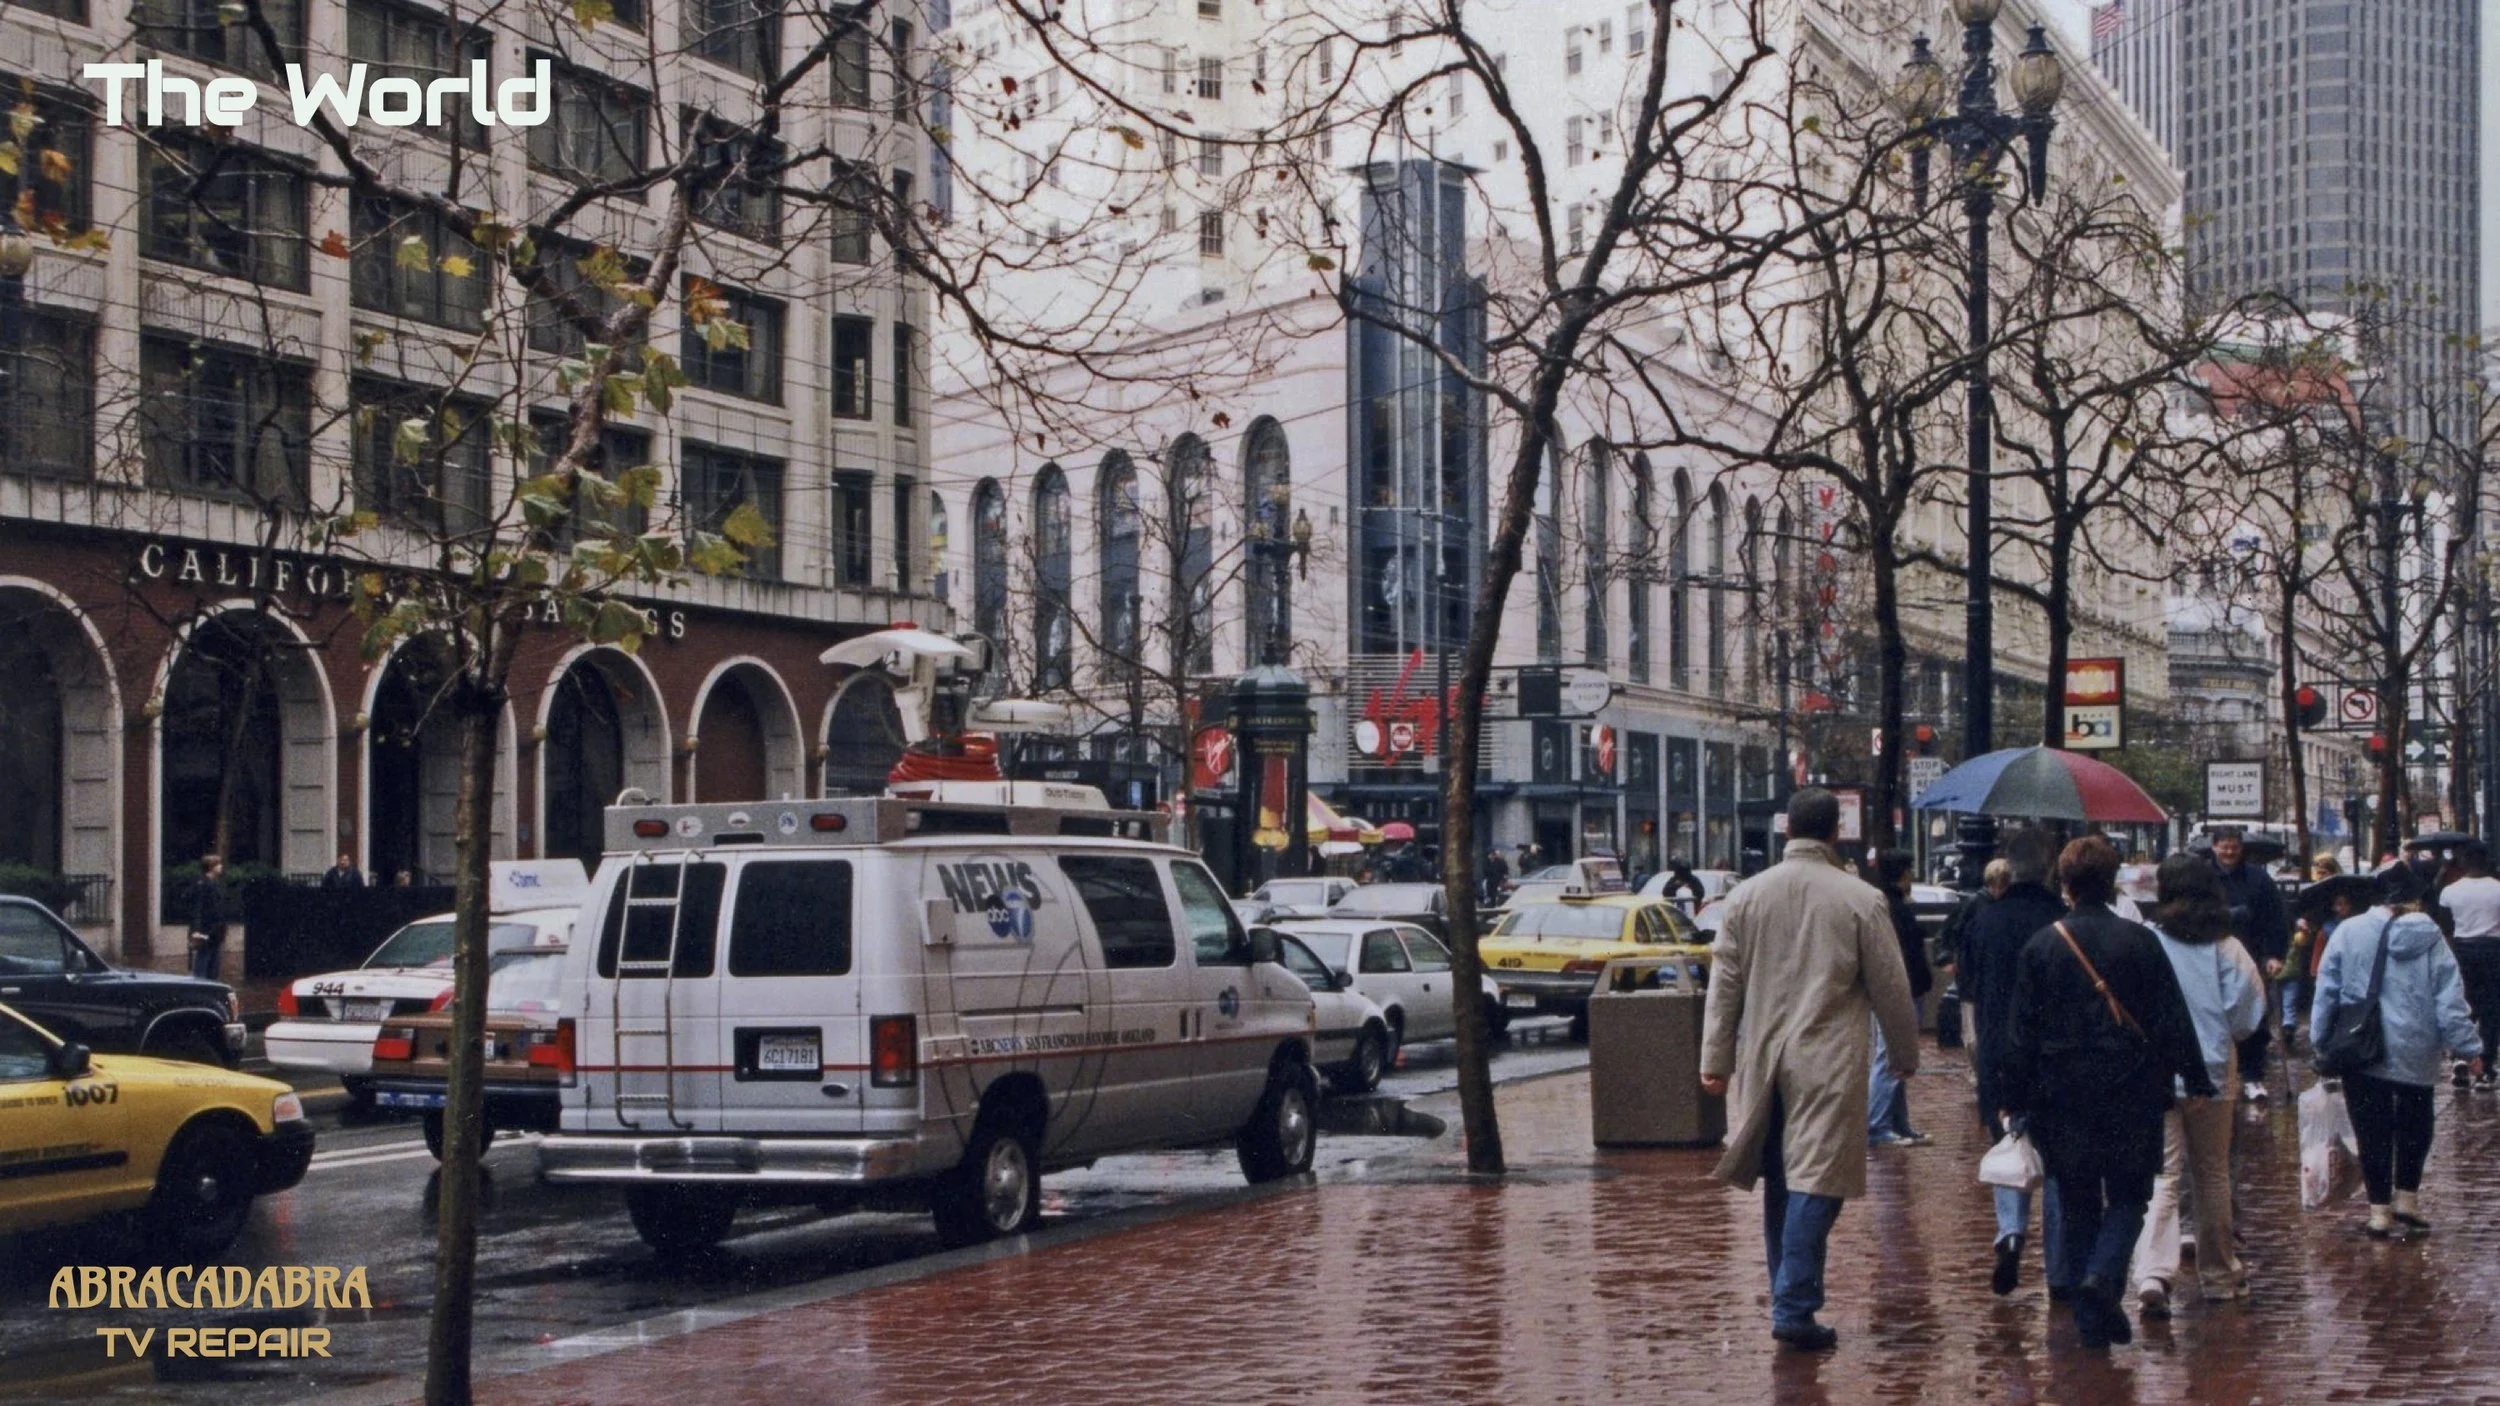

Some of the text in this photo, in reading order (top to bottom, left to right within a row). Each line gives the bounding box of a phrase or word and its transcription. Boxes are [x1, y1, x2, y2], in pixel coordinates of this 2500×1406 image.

[2217, 784, 2252, 794] MUST
[936, 862, 1042, 914] NEWS
[312, 981, 345, 996] 944
[62, 1083, 119, 1107] 1007
